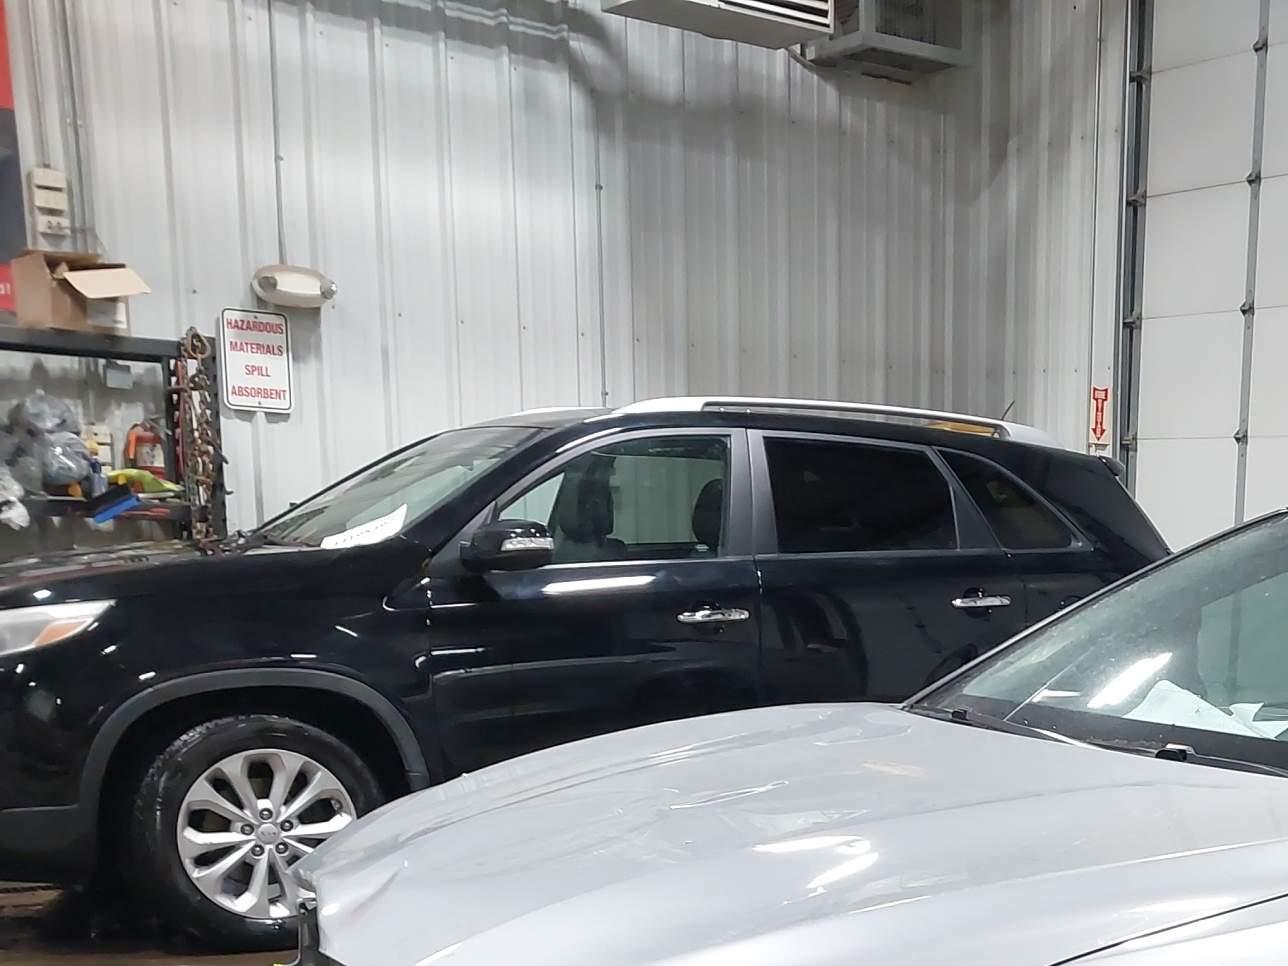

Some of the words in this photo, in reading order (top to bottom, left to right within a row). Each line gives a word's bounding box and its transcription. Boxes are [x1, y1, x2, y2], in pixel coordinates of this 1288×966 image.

[226, 319, 284, 335] HAZARDOUS
[230, 341, 283, 356] MATERIALS
[245, 364, 271, 377] SPILL
[231, 384, 287, 400] ABSORBENT
